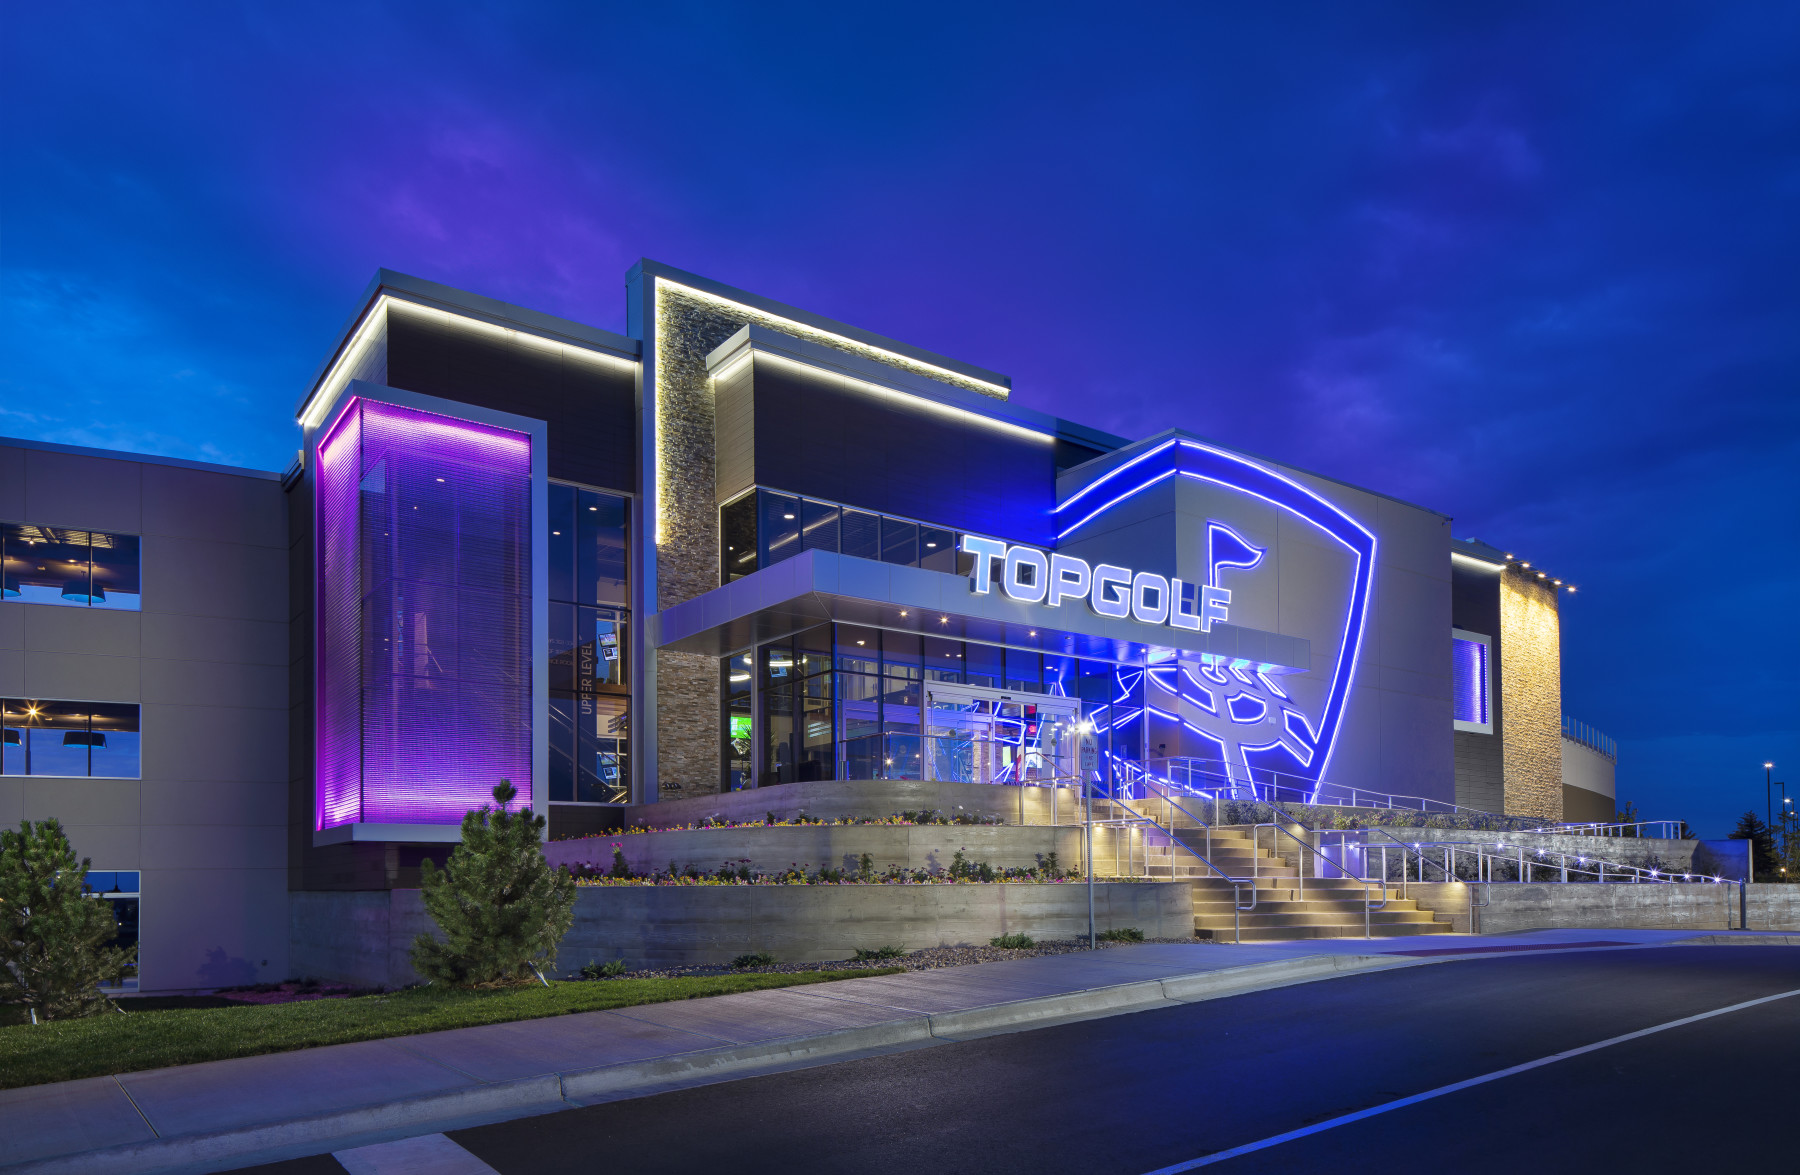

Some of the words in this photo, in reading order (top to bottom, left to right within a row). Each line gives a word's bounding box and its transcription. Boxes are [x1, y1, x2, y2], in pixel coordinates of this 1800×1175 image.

[960, 534, 1232, 633] TOPGOLF
[581, 643, 593, 675] LEVEL
[581, 679, 593, 715] UPPER
